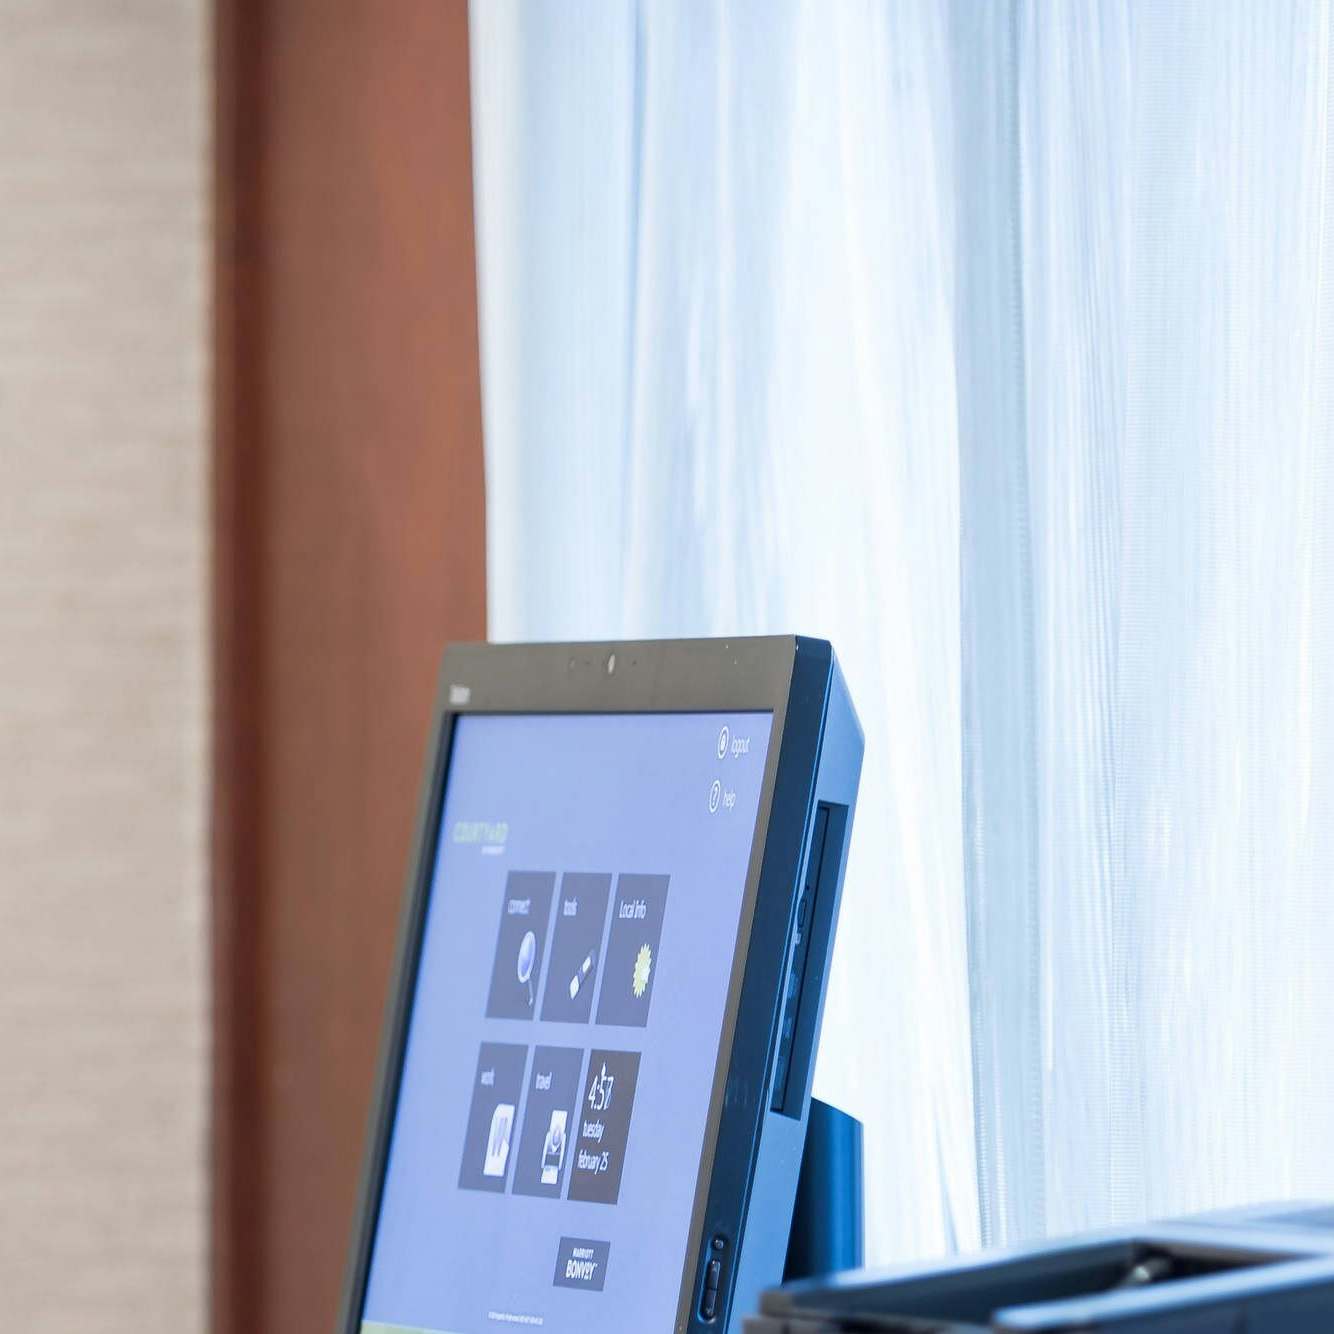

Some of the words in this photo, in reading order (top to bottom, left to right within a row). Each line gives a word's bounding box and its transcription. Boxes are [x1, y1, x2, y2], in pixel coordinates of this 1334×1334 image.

[582, 1119, 605, 1144] tuesday
[577, 1149, 601, 1175] february
[599, 1151, 609, 1171] 25
